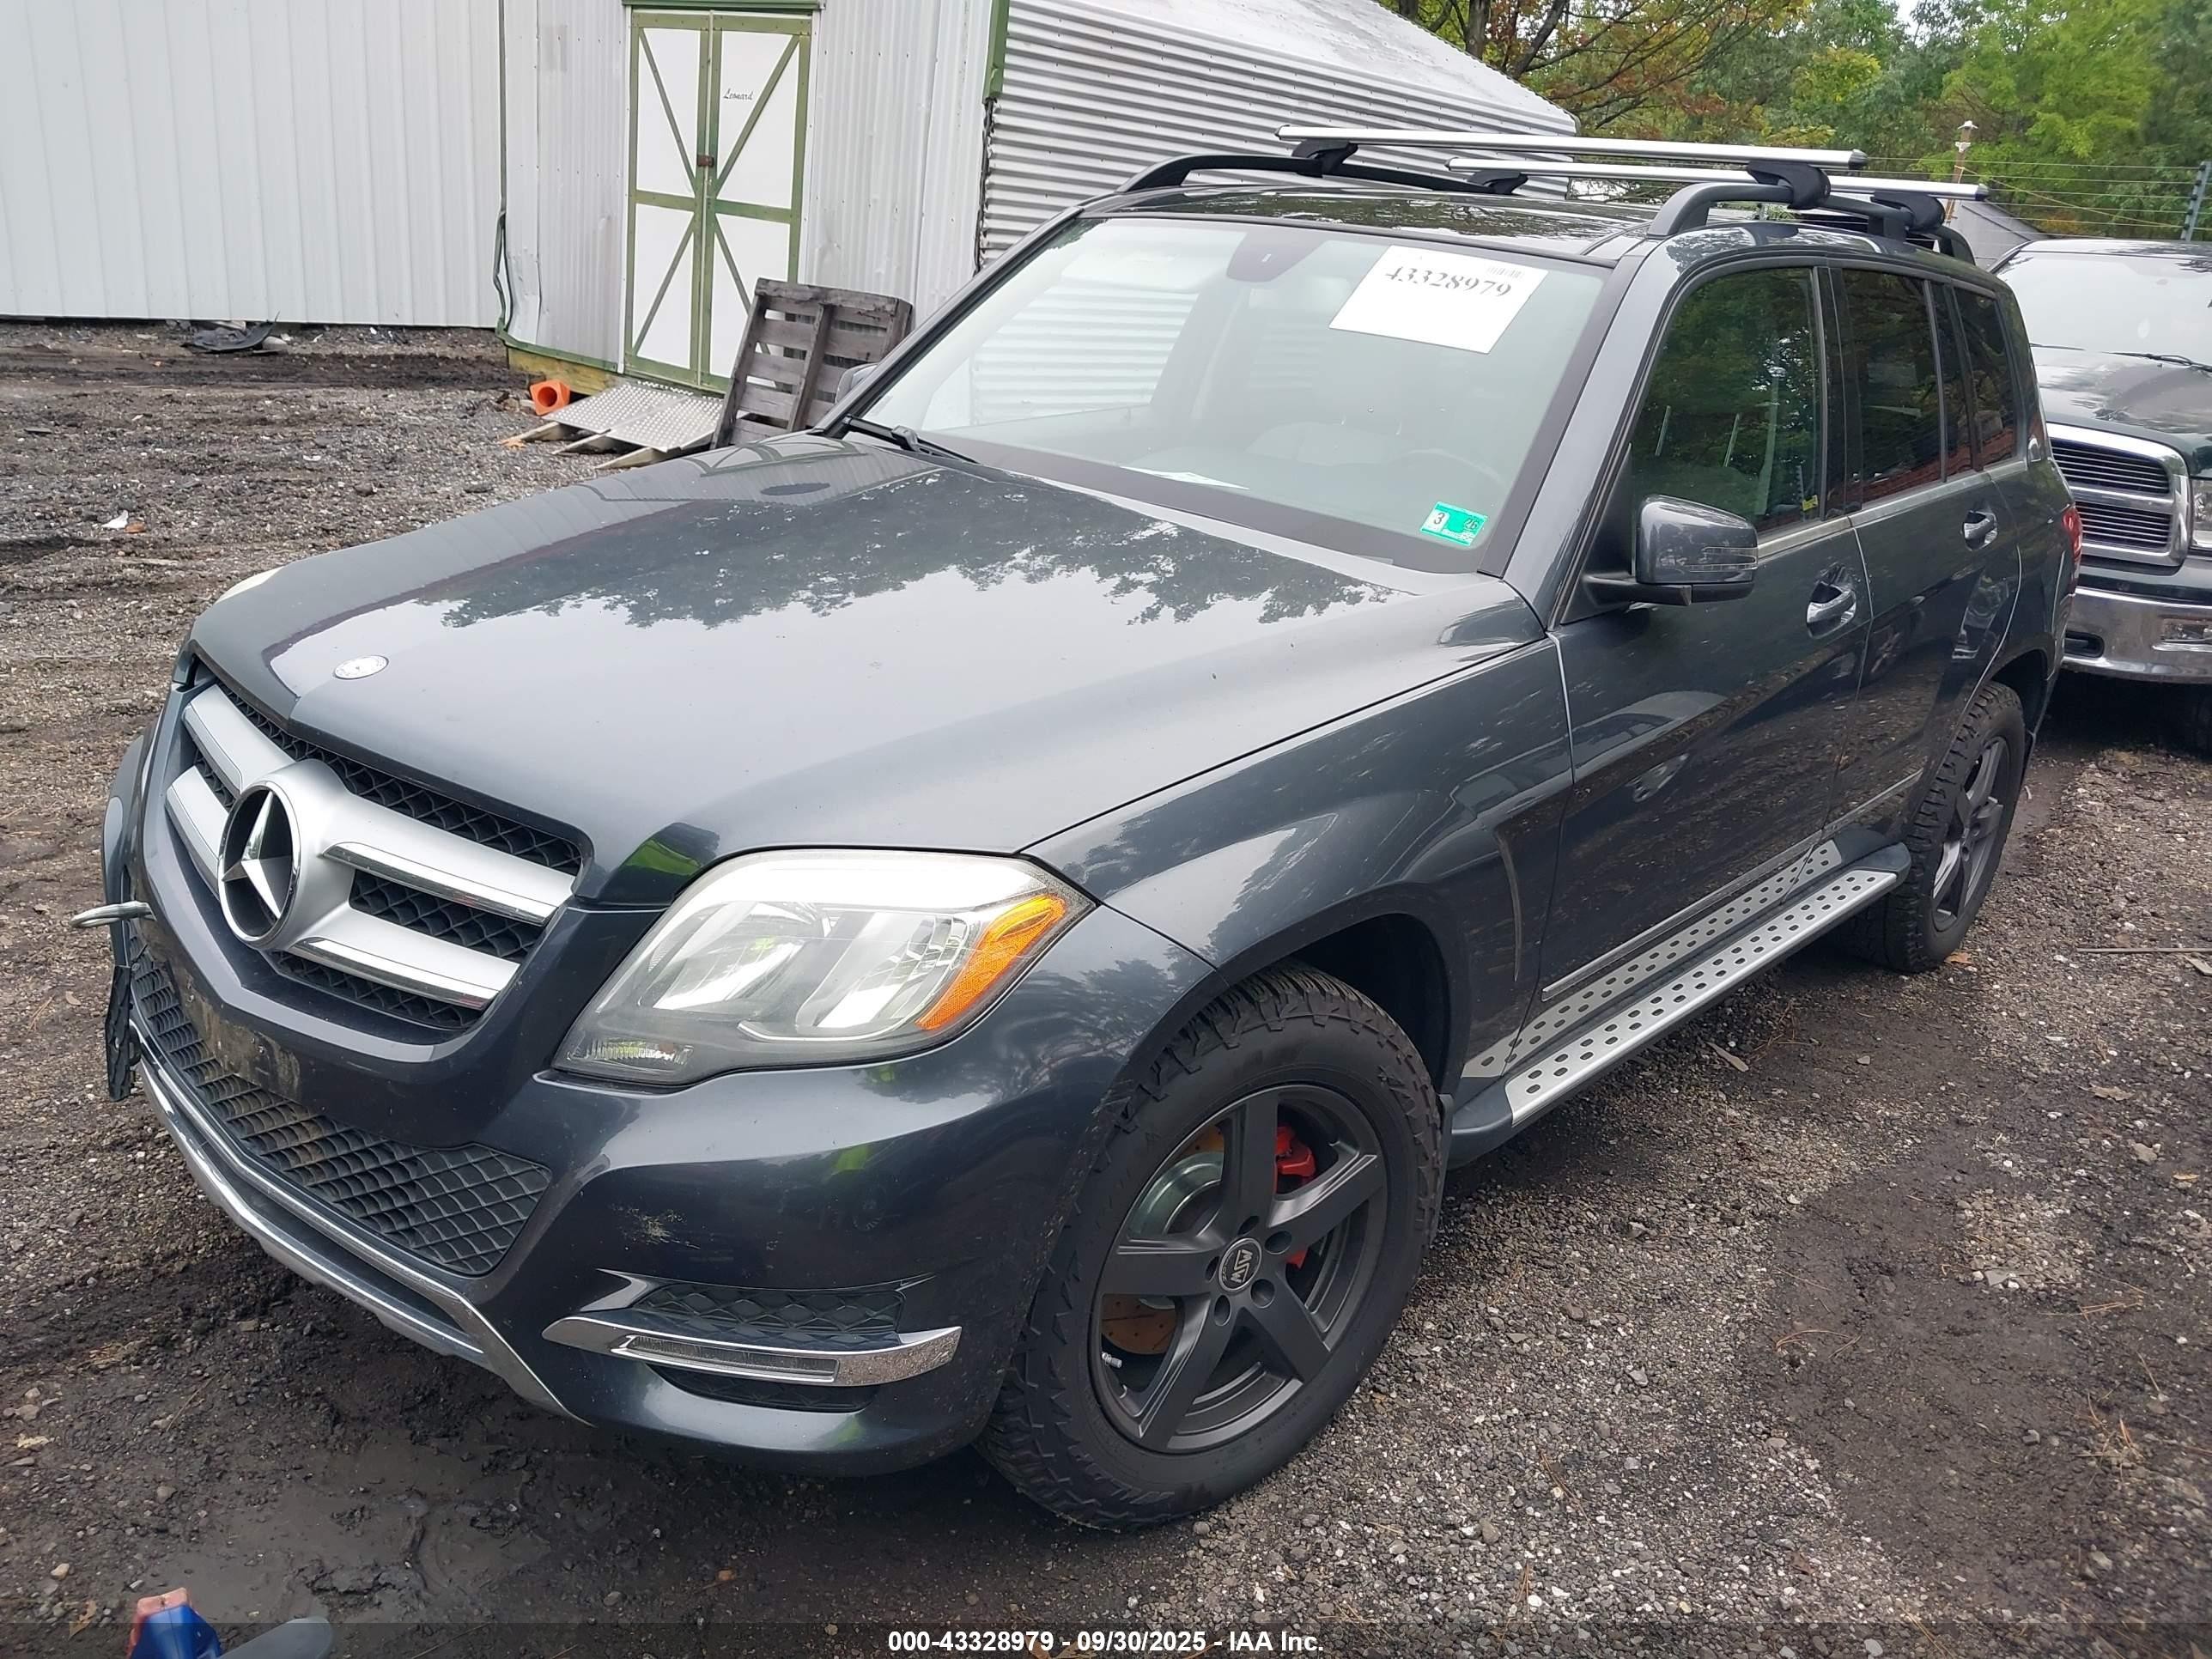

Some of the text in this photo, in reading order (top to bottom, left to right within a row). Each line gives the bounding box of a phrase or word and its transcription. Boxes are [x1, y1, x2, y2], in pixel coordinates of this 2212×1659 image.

[723, 88, 754, 100] Leonard
[1385, 266, 1512, 298] 43328979
[1433, 512, 1446, 525] 3
